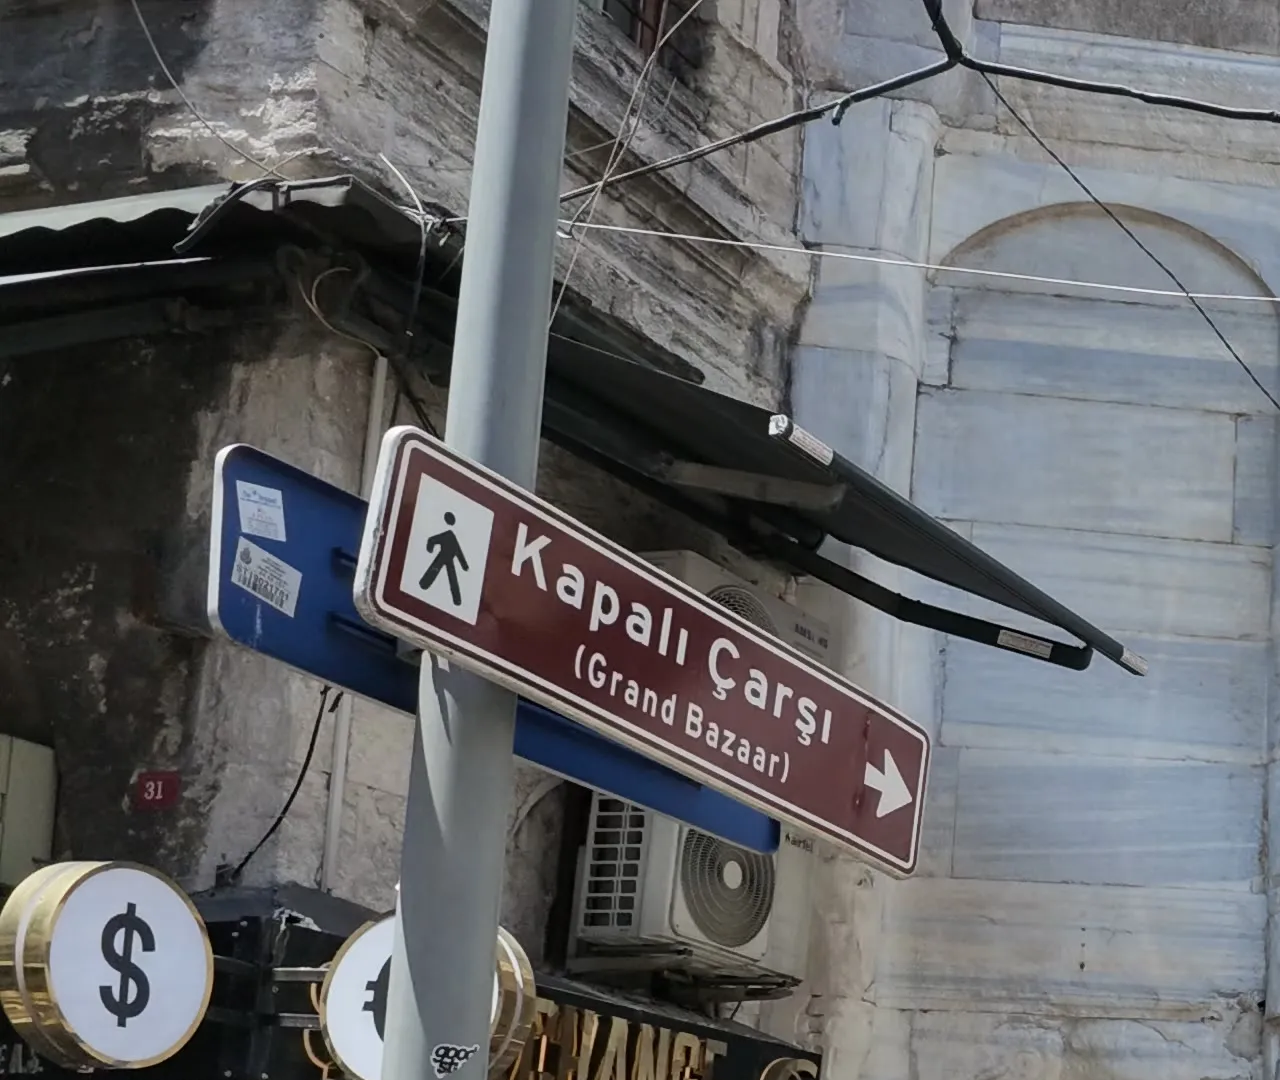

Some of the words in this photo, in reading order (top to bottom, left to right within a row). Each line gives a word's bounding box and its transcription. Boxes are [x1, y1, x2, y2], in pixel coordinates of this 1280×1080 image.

[511, 522, 689, 666] Kapalı
[708, 637, 833, 747] Çarşı
[574, 644, 677, 726] (Grand
[685, 702, 791, 783] Bazaar)
[144, 780, 163, 800] 31
